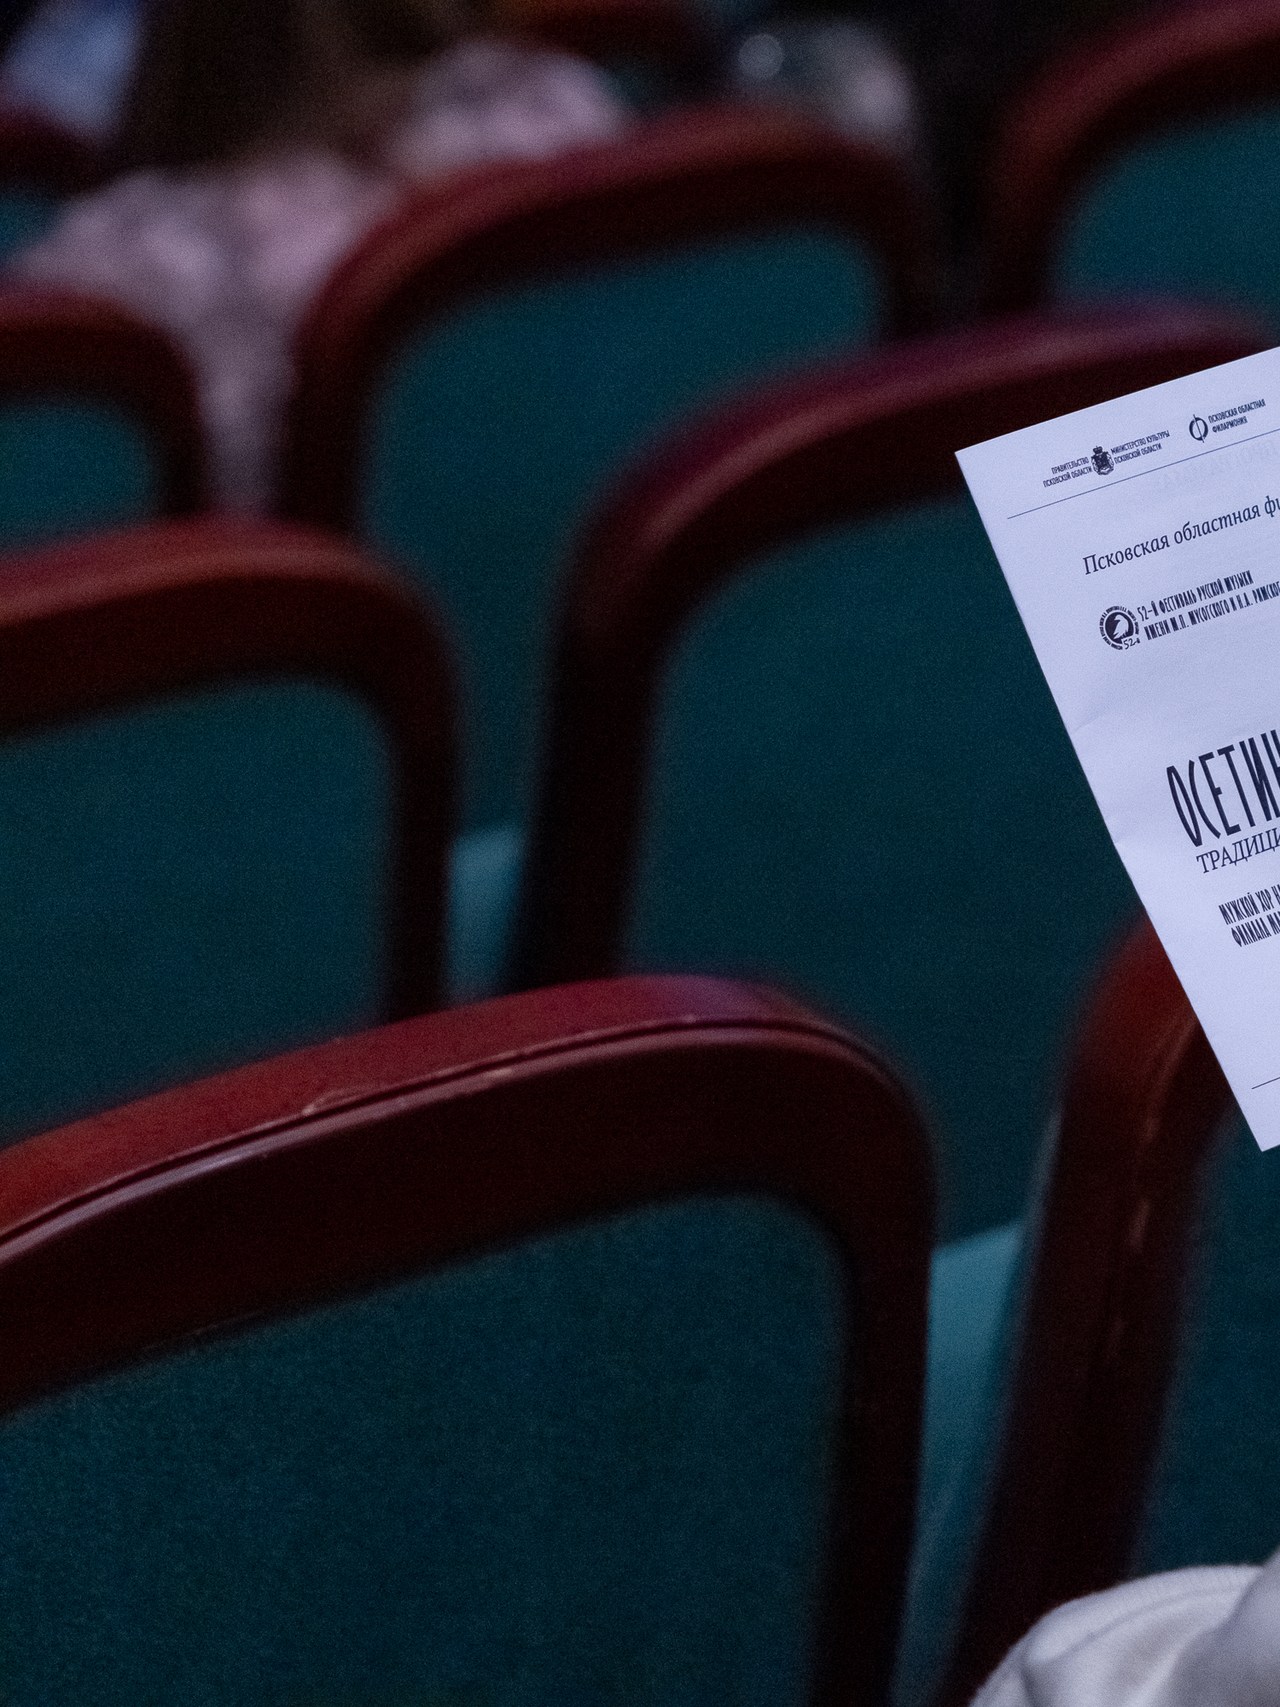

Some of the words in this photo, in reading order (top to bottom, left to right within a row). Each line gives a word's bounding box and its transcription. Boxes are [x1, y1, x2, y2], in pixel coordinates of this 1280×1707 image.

[1208, 407, 1238, 423] ПСКОВСКАЯ
[1238, 398, 1266, 413] ОБЛАСТНАЯ
[1212, 416, 1248, 433] ФИЛАРМОНИЯ
[1110, 438, 1147, 455] МИНИСТЕРСТВО
[1146, 430, 1170, 444] КУЛЬТУРЫ
[1114, 448, 1141, 464] ПСКОВСКОЙ
[1141, 443, 1162, 455] ОБЛАСТИ
[1043, 472, 1071, 487] ПСКОВСКОЙ
[1071, 466, 1093, 479] ОБЛАСТИ
[1051, 456, 1089, 474] ПРАВИТЕЛЬСТВО
[1082, 534, 1171, 575] Псковская
[1174, 504, 1261, 544] областная
[1159, 589, 1197, 614] ФЕСТИВАЛЬ
[1196, 578, 1226, 602] РУССКОЙ
[1224, 570, 1255, 592] МУЗЫКИ
[1144, 619, 1171, 641] ИМЕНИ
[1170, 614, 1190, 632] М.П.
[1229, 596, 1238, 612] И
[1238, 592, 1253, 610] Н.А.
[1218, 892, 1260, 925] МУЖСКОЙ
[1255, 888, 1275, 912] ХОР
[1231, 917, 1272, 947] ФИЛИАЛА
